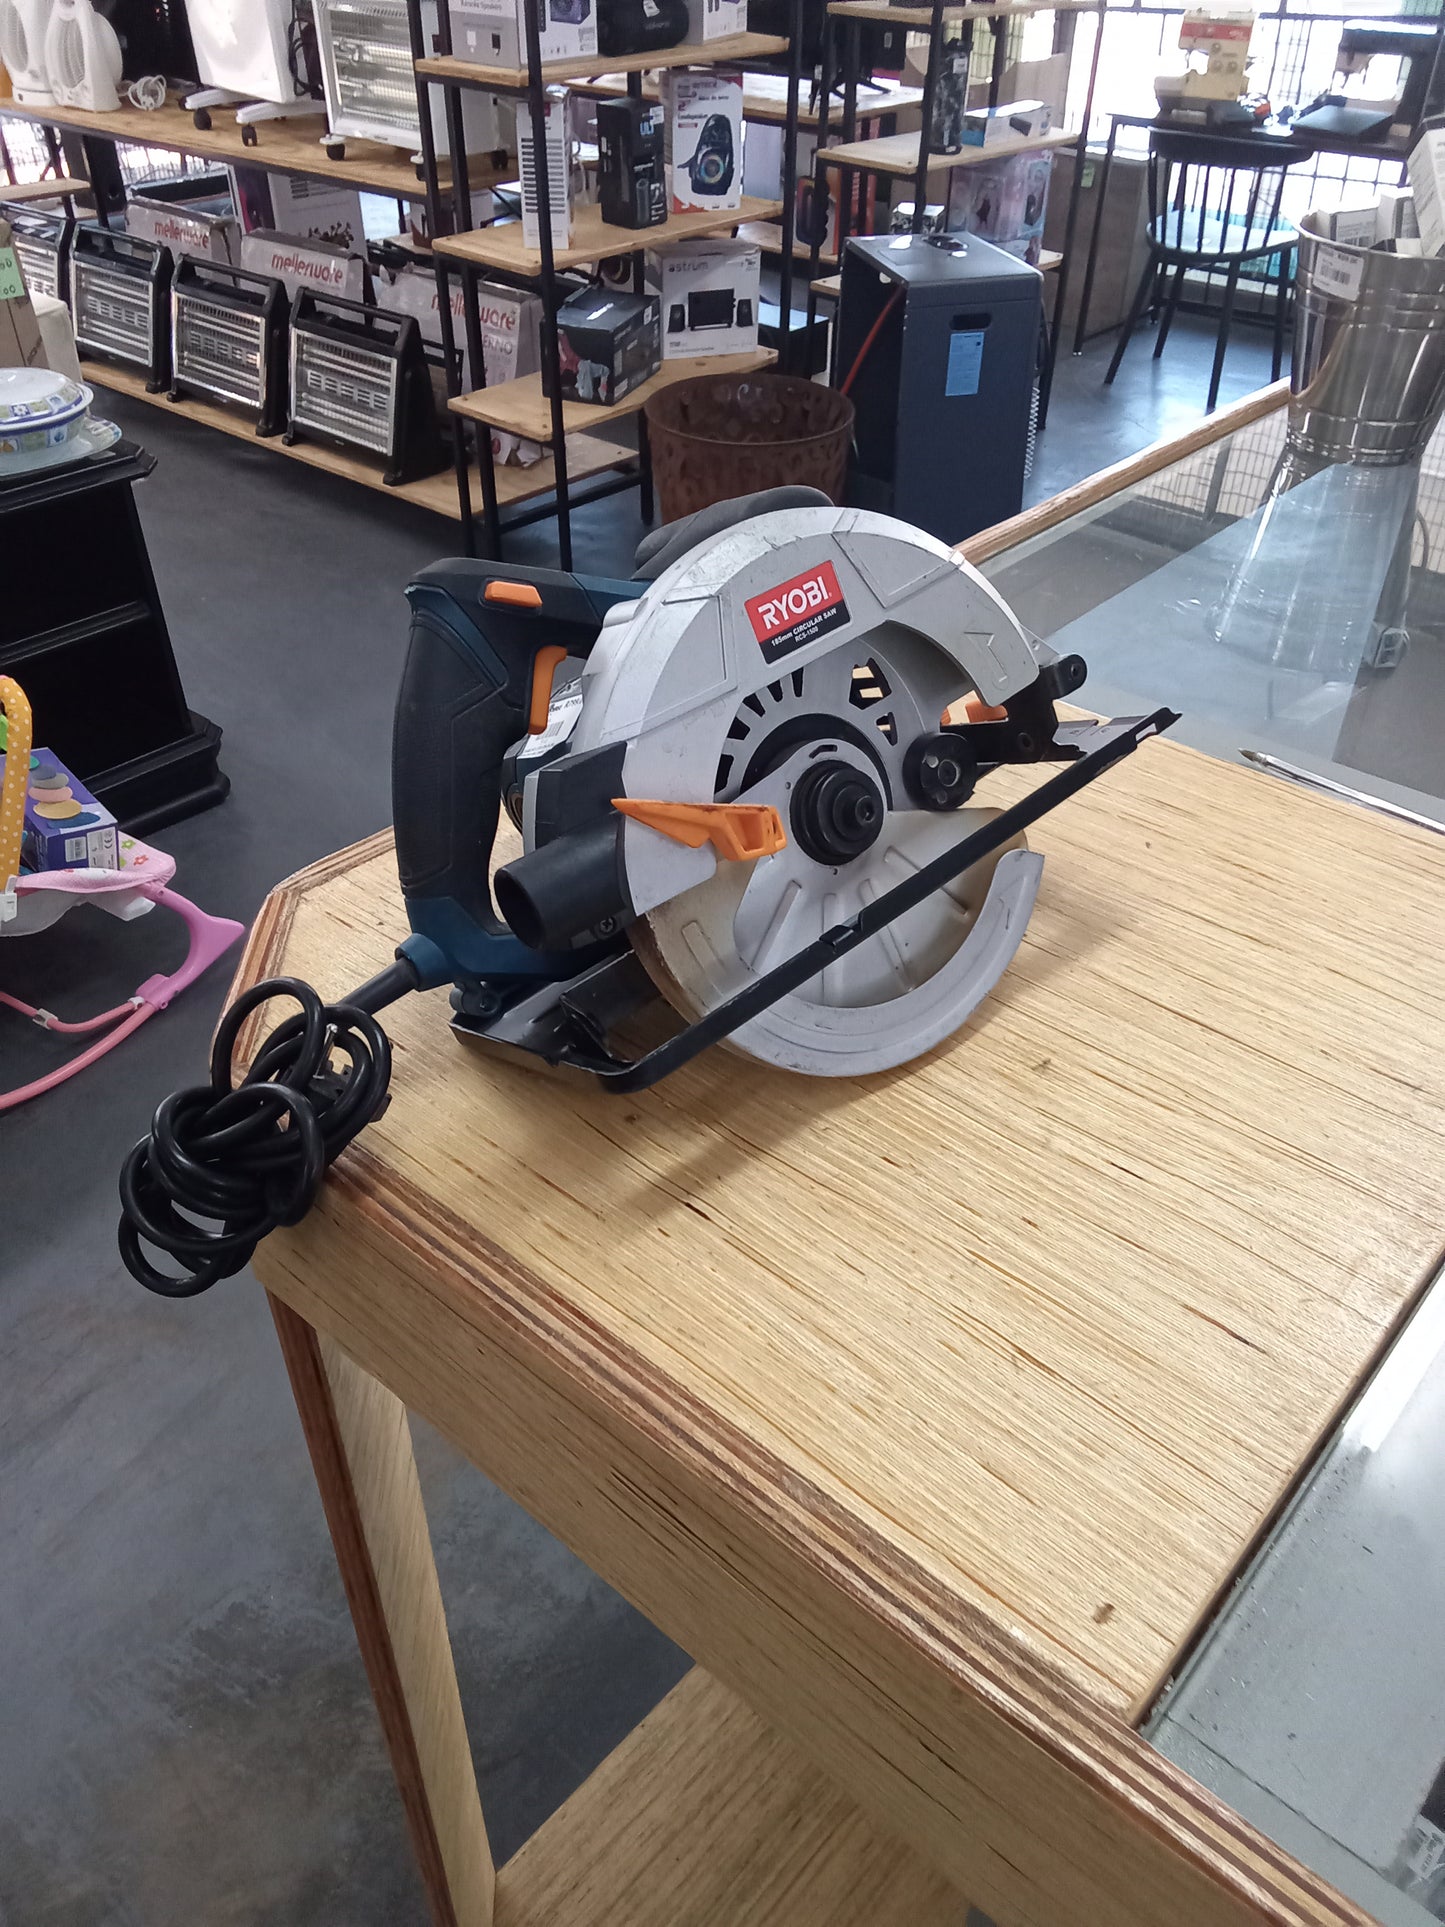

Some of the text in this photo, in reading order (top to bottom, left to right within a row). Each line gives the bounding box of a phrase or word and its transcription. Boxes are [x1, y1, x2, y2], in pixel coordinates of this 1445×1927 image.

[758, 576, 828, 629] RYOBI
[771, 608, 837, 646] 185mm CIRCULAR SAW
